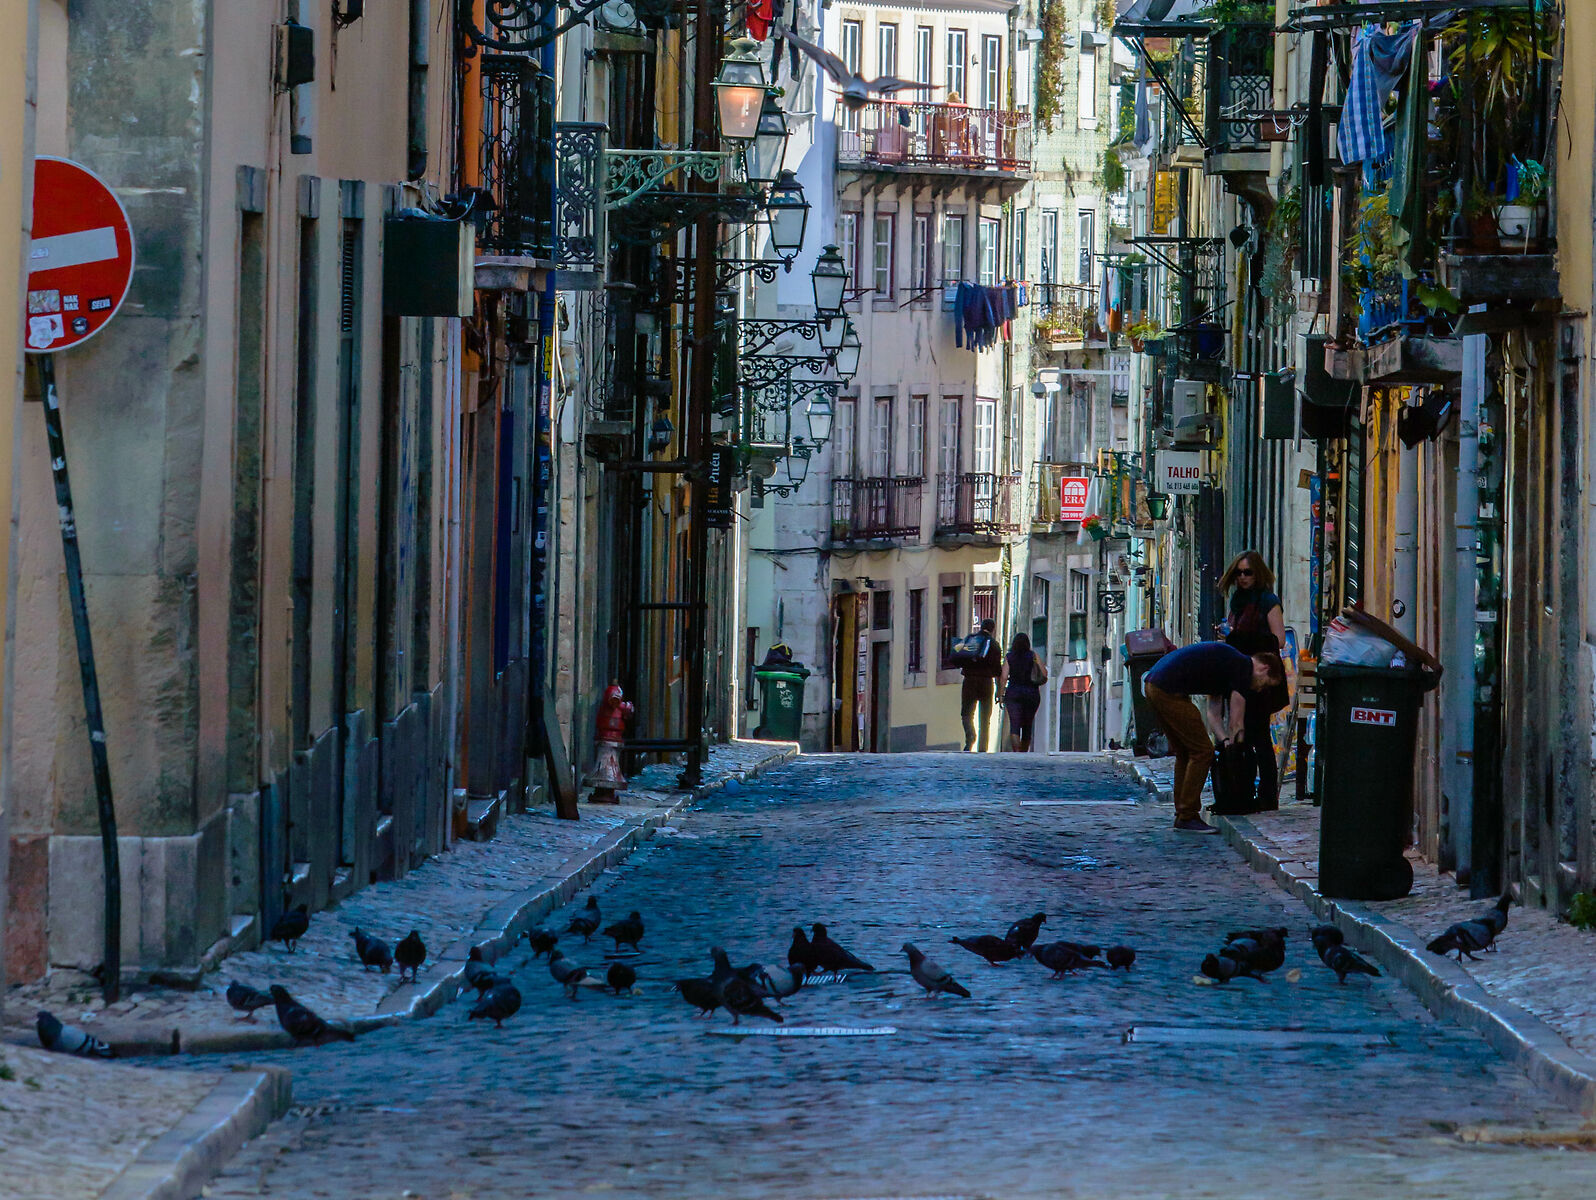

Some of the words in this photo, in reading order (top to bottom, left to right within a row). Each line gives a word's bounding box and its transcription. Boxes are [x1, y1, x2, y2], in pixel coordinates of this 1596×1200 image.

[1167, 466, 1200, 479] TALHO
[1064, 495, 1084, 504] ERA
[1354, 710, 1394, 723] BNT
